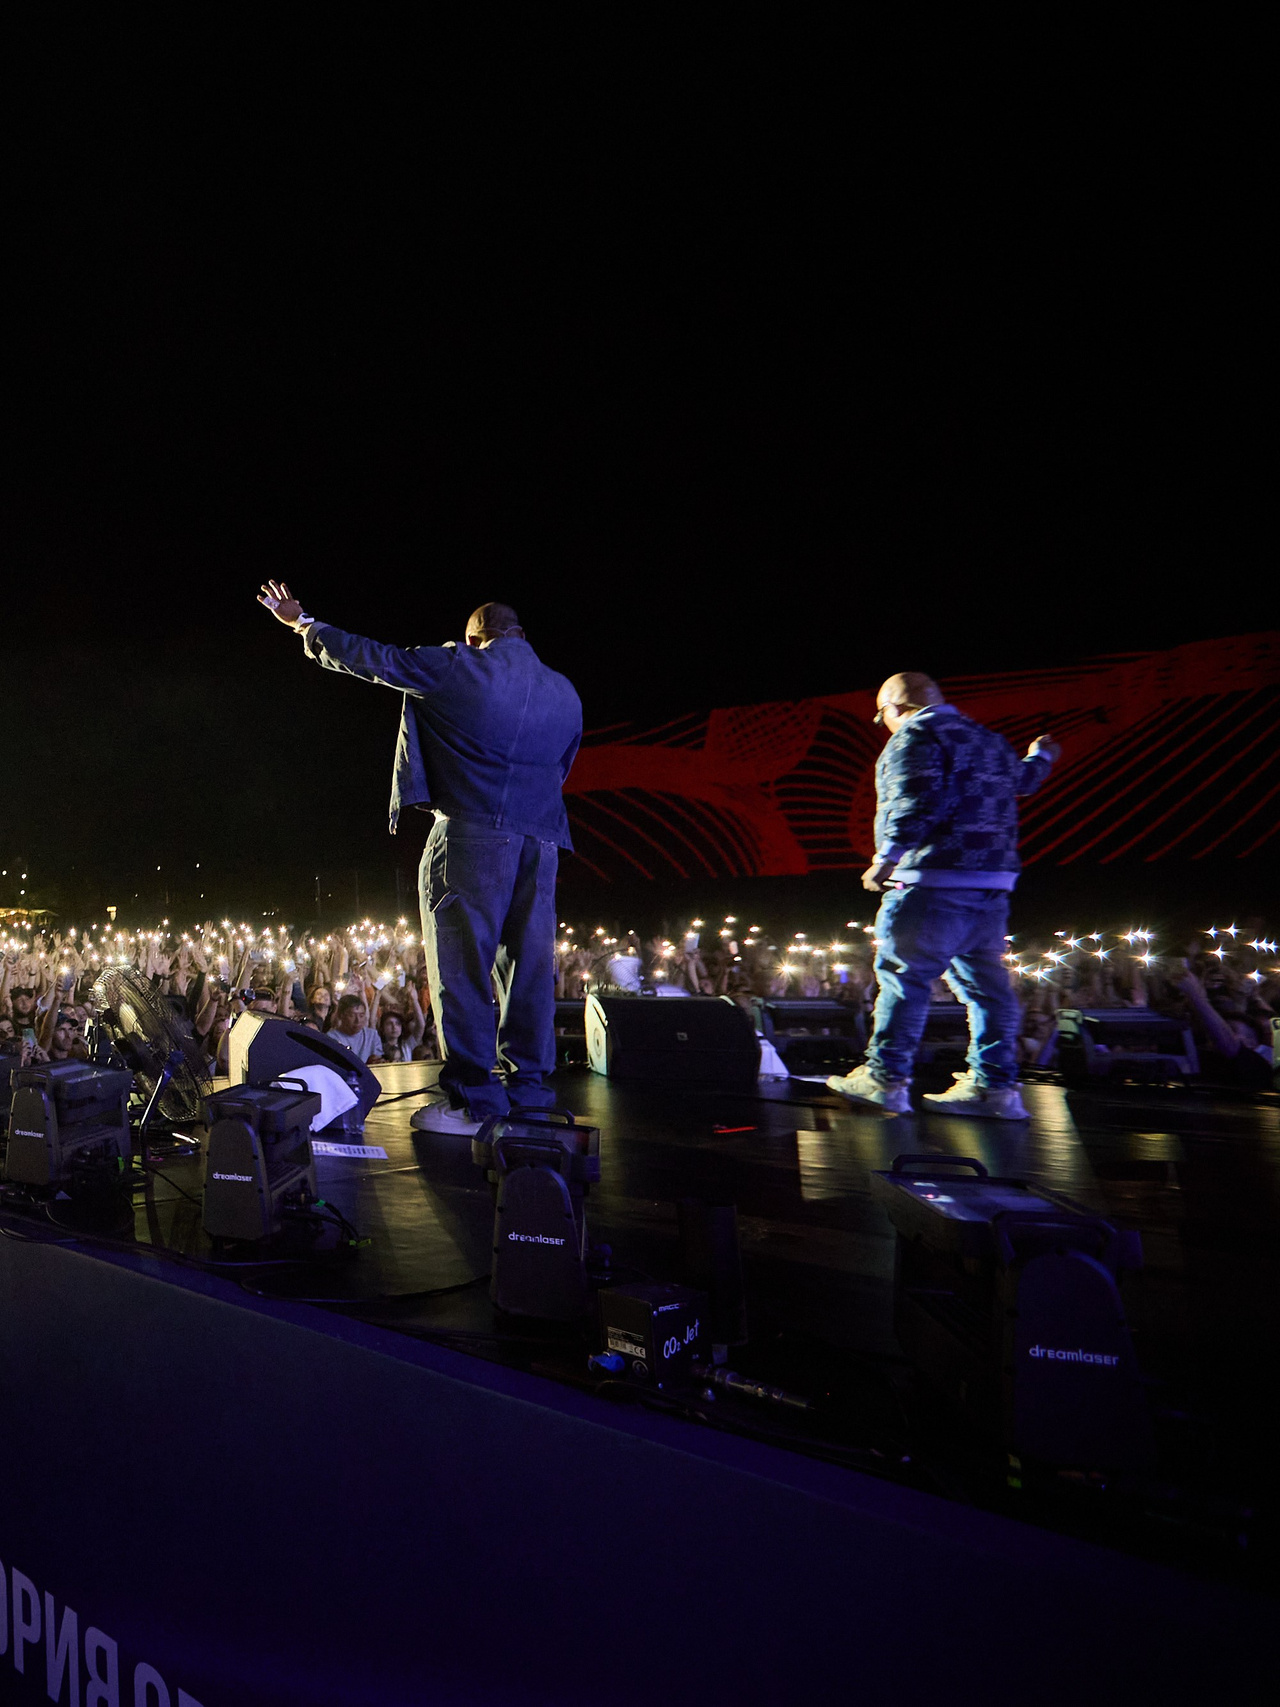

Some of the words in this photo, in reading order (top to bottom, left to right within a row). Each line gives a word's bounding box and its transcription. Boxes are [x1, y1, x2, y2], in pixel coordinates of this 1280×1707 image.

[14, 1129, 45, 1139] dreamlaser
[212, 1171, 254, 1183] dreamlaser
[508, 1231, 566, 1247] dreamlaser
[683, 1318, 700, 1344] Jet
[1028, 1344, 1120, 1366] dreamlaser
